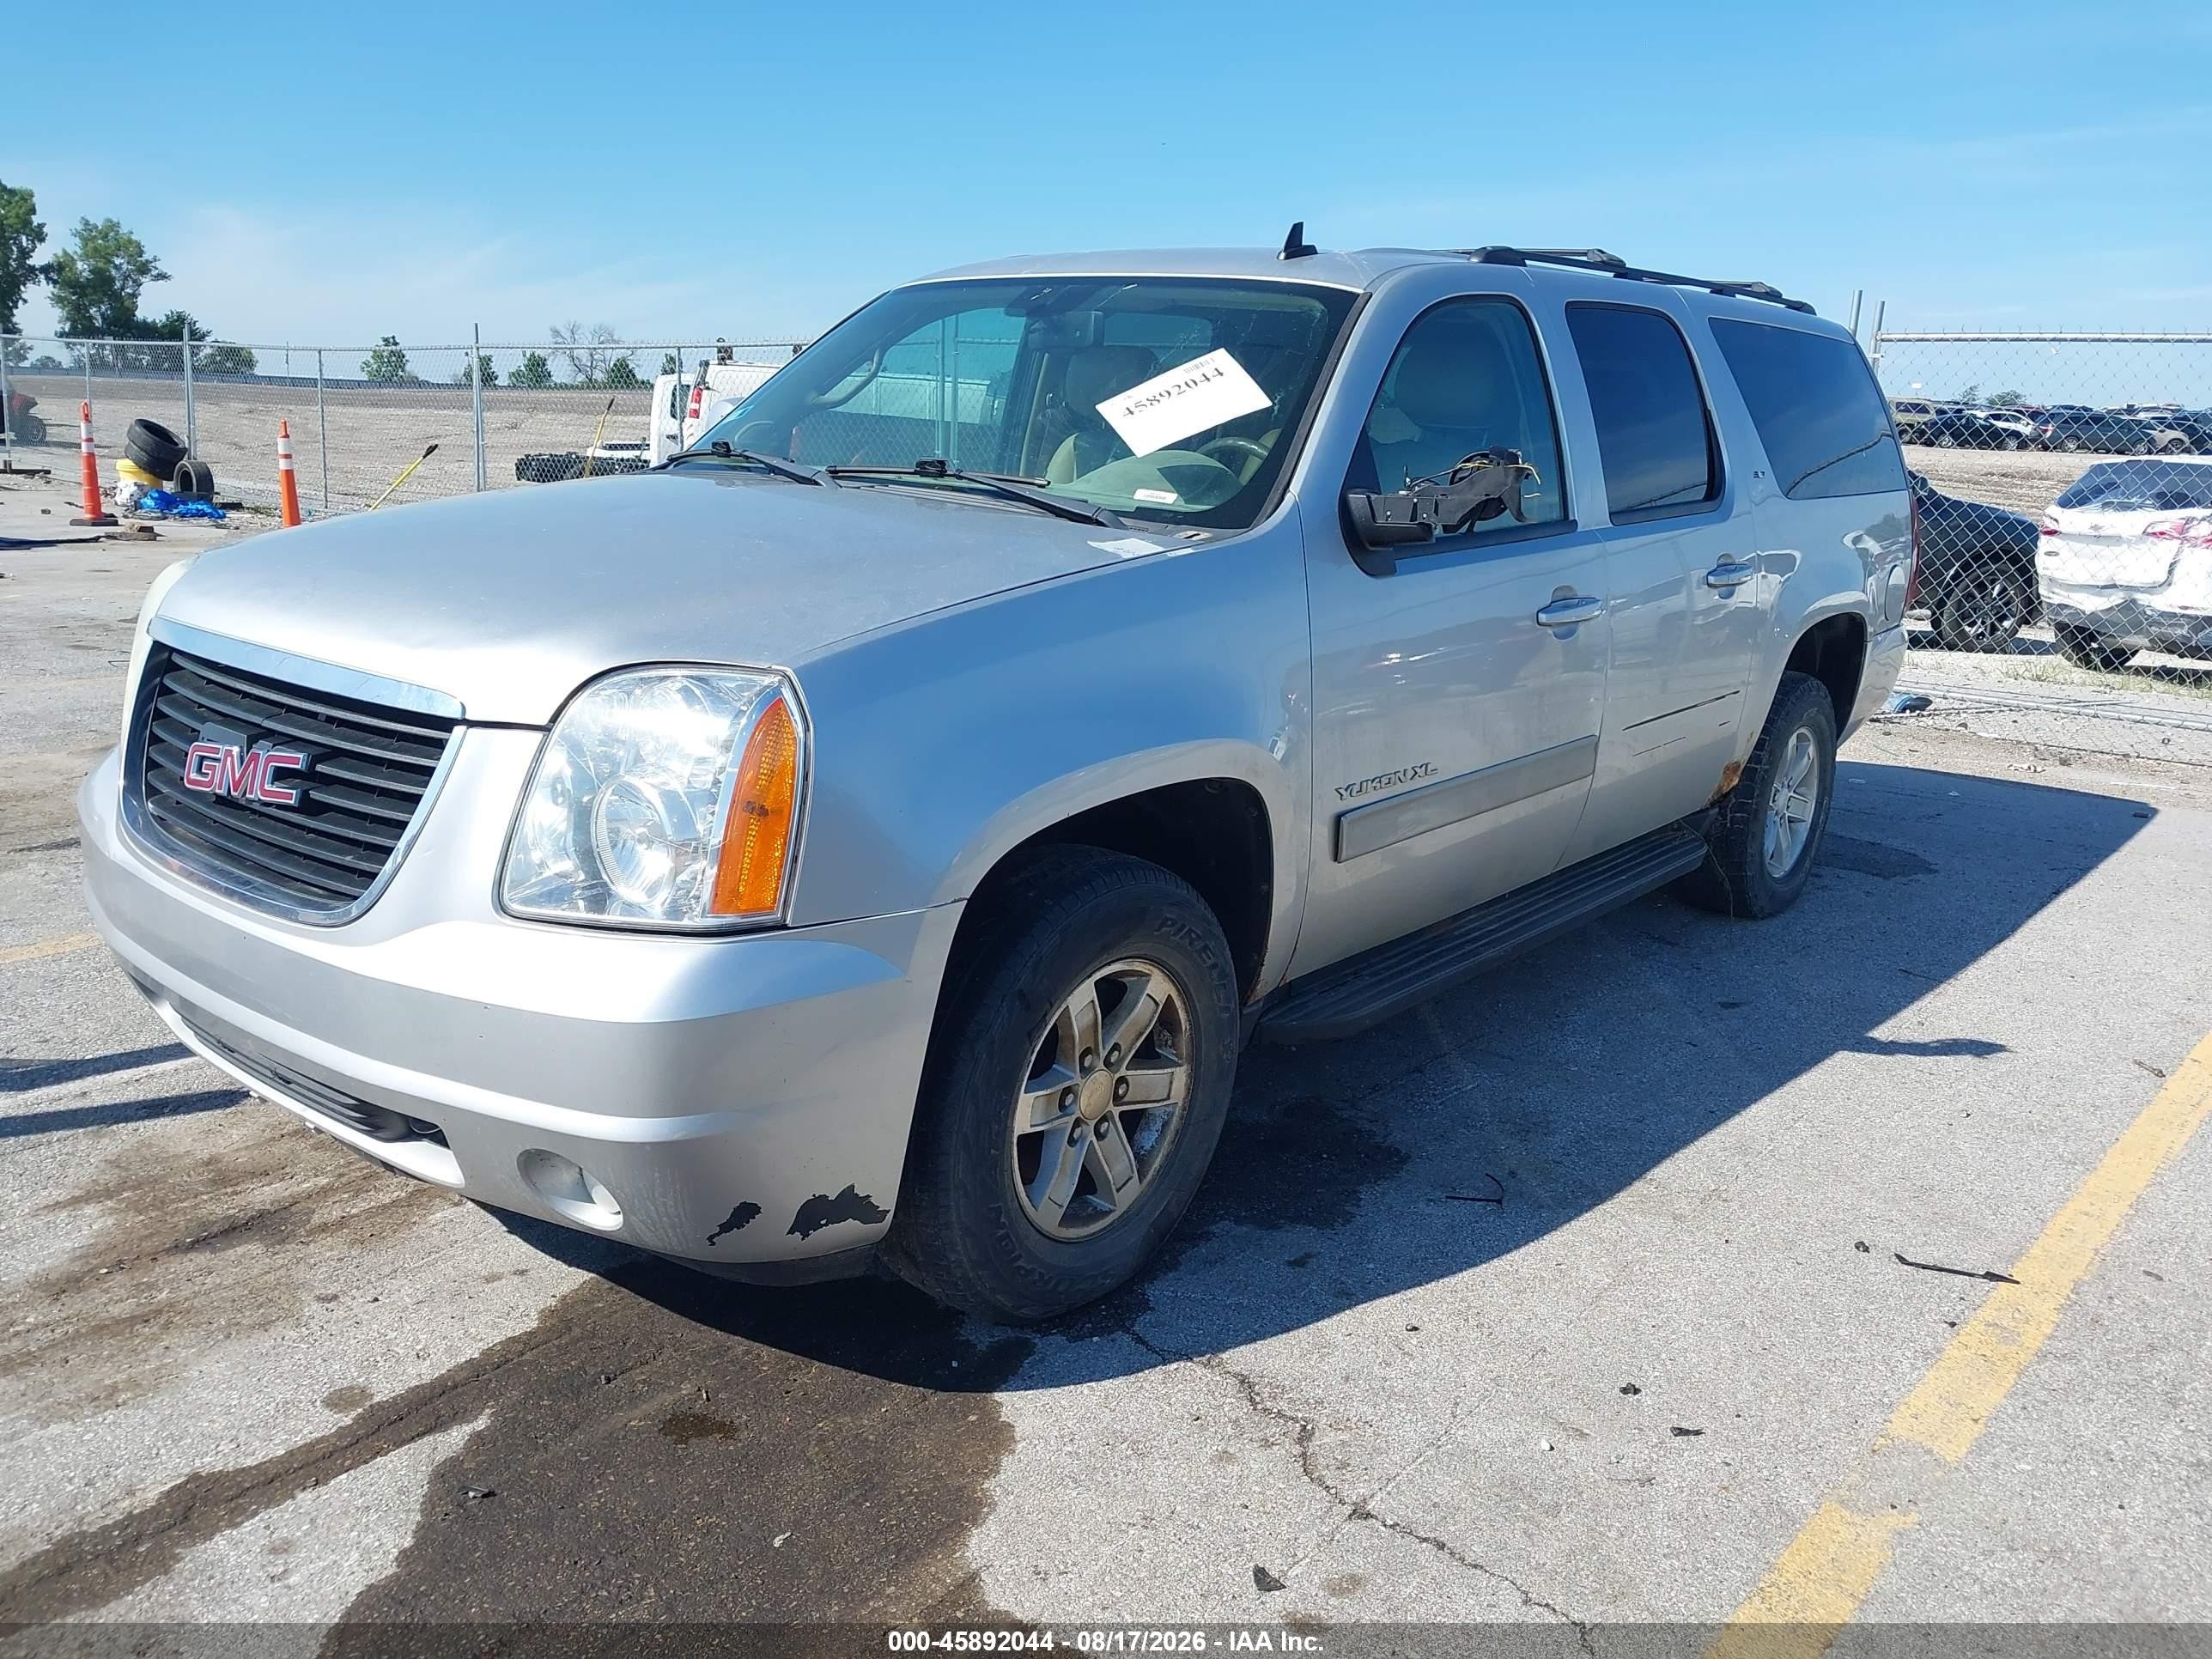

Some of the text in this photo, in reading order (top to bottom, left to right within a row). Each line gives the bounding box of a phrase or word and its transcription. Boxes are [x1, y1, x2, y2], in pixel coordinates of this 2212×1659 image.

[1122, 367, 1224, 417] 45892044
[184, 742, 307, 806] GMC
[1409, 762, 1438, 781] XL
